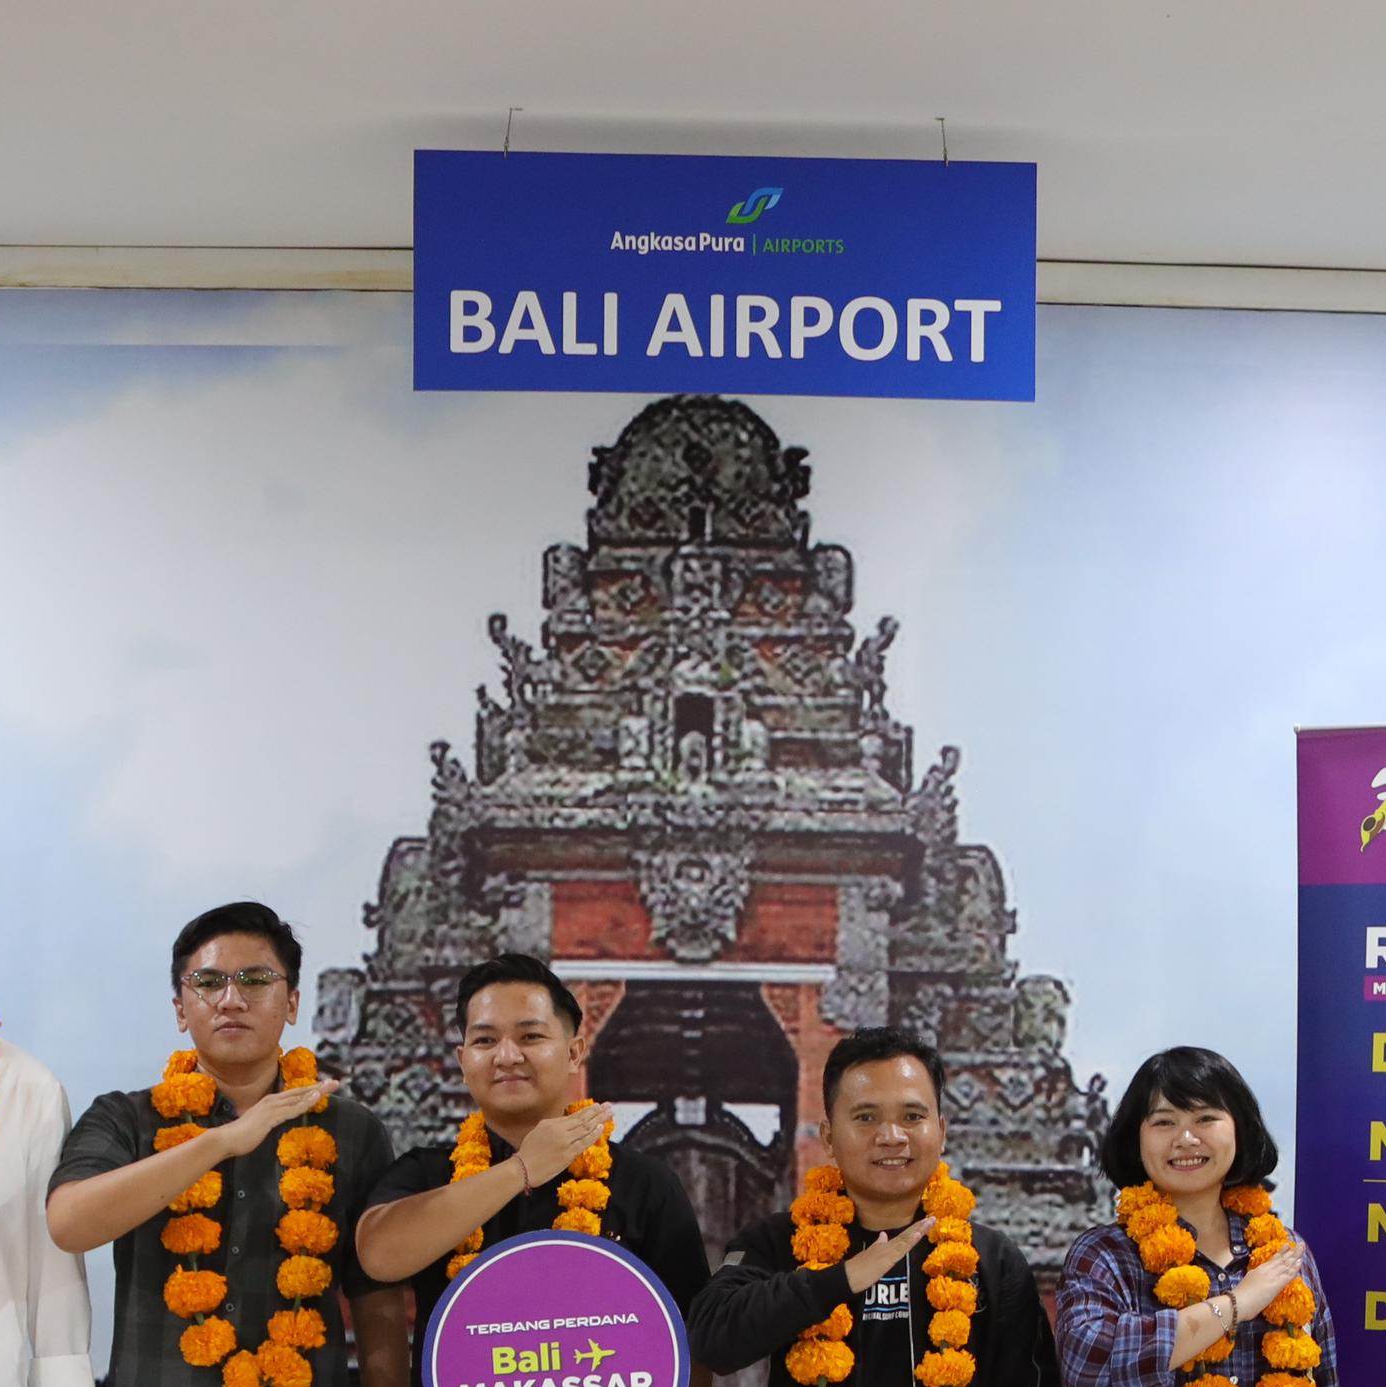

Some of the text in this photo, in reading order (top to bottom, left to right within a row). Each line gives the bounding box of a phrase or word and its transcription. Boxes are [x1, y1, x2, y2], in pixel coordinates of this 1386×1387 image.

[762, 238, 845, 255] AIRPORTS
[448, 289, 1003, 364] BALI AIRPORT
[864, 1282, 910, 1305] URLE
[465, 1313, 639, 1335] TERBANG PERDANA
[491, 1342, 562, 1375] Bali
